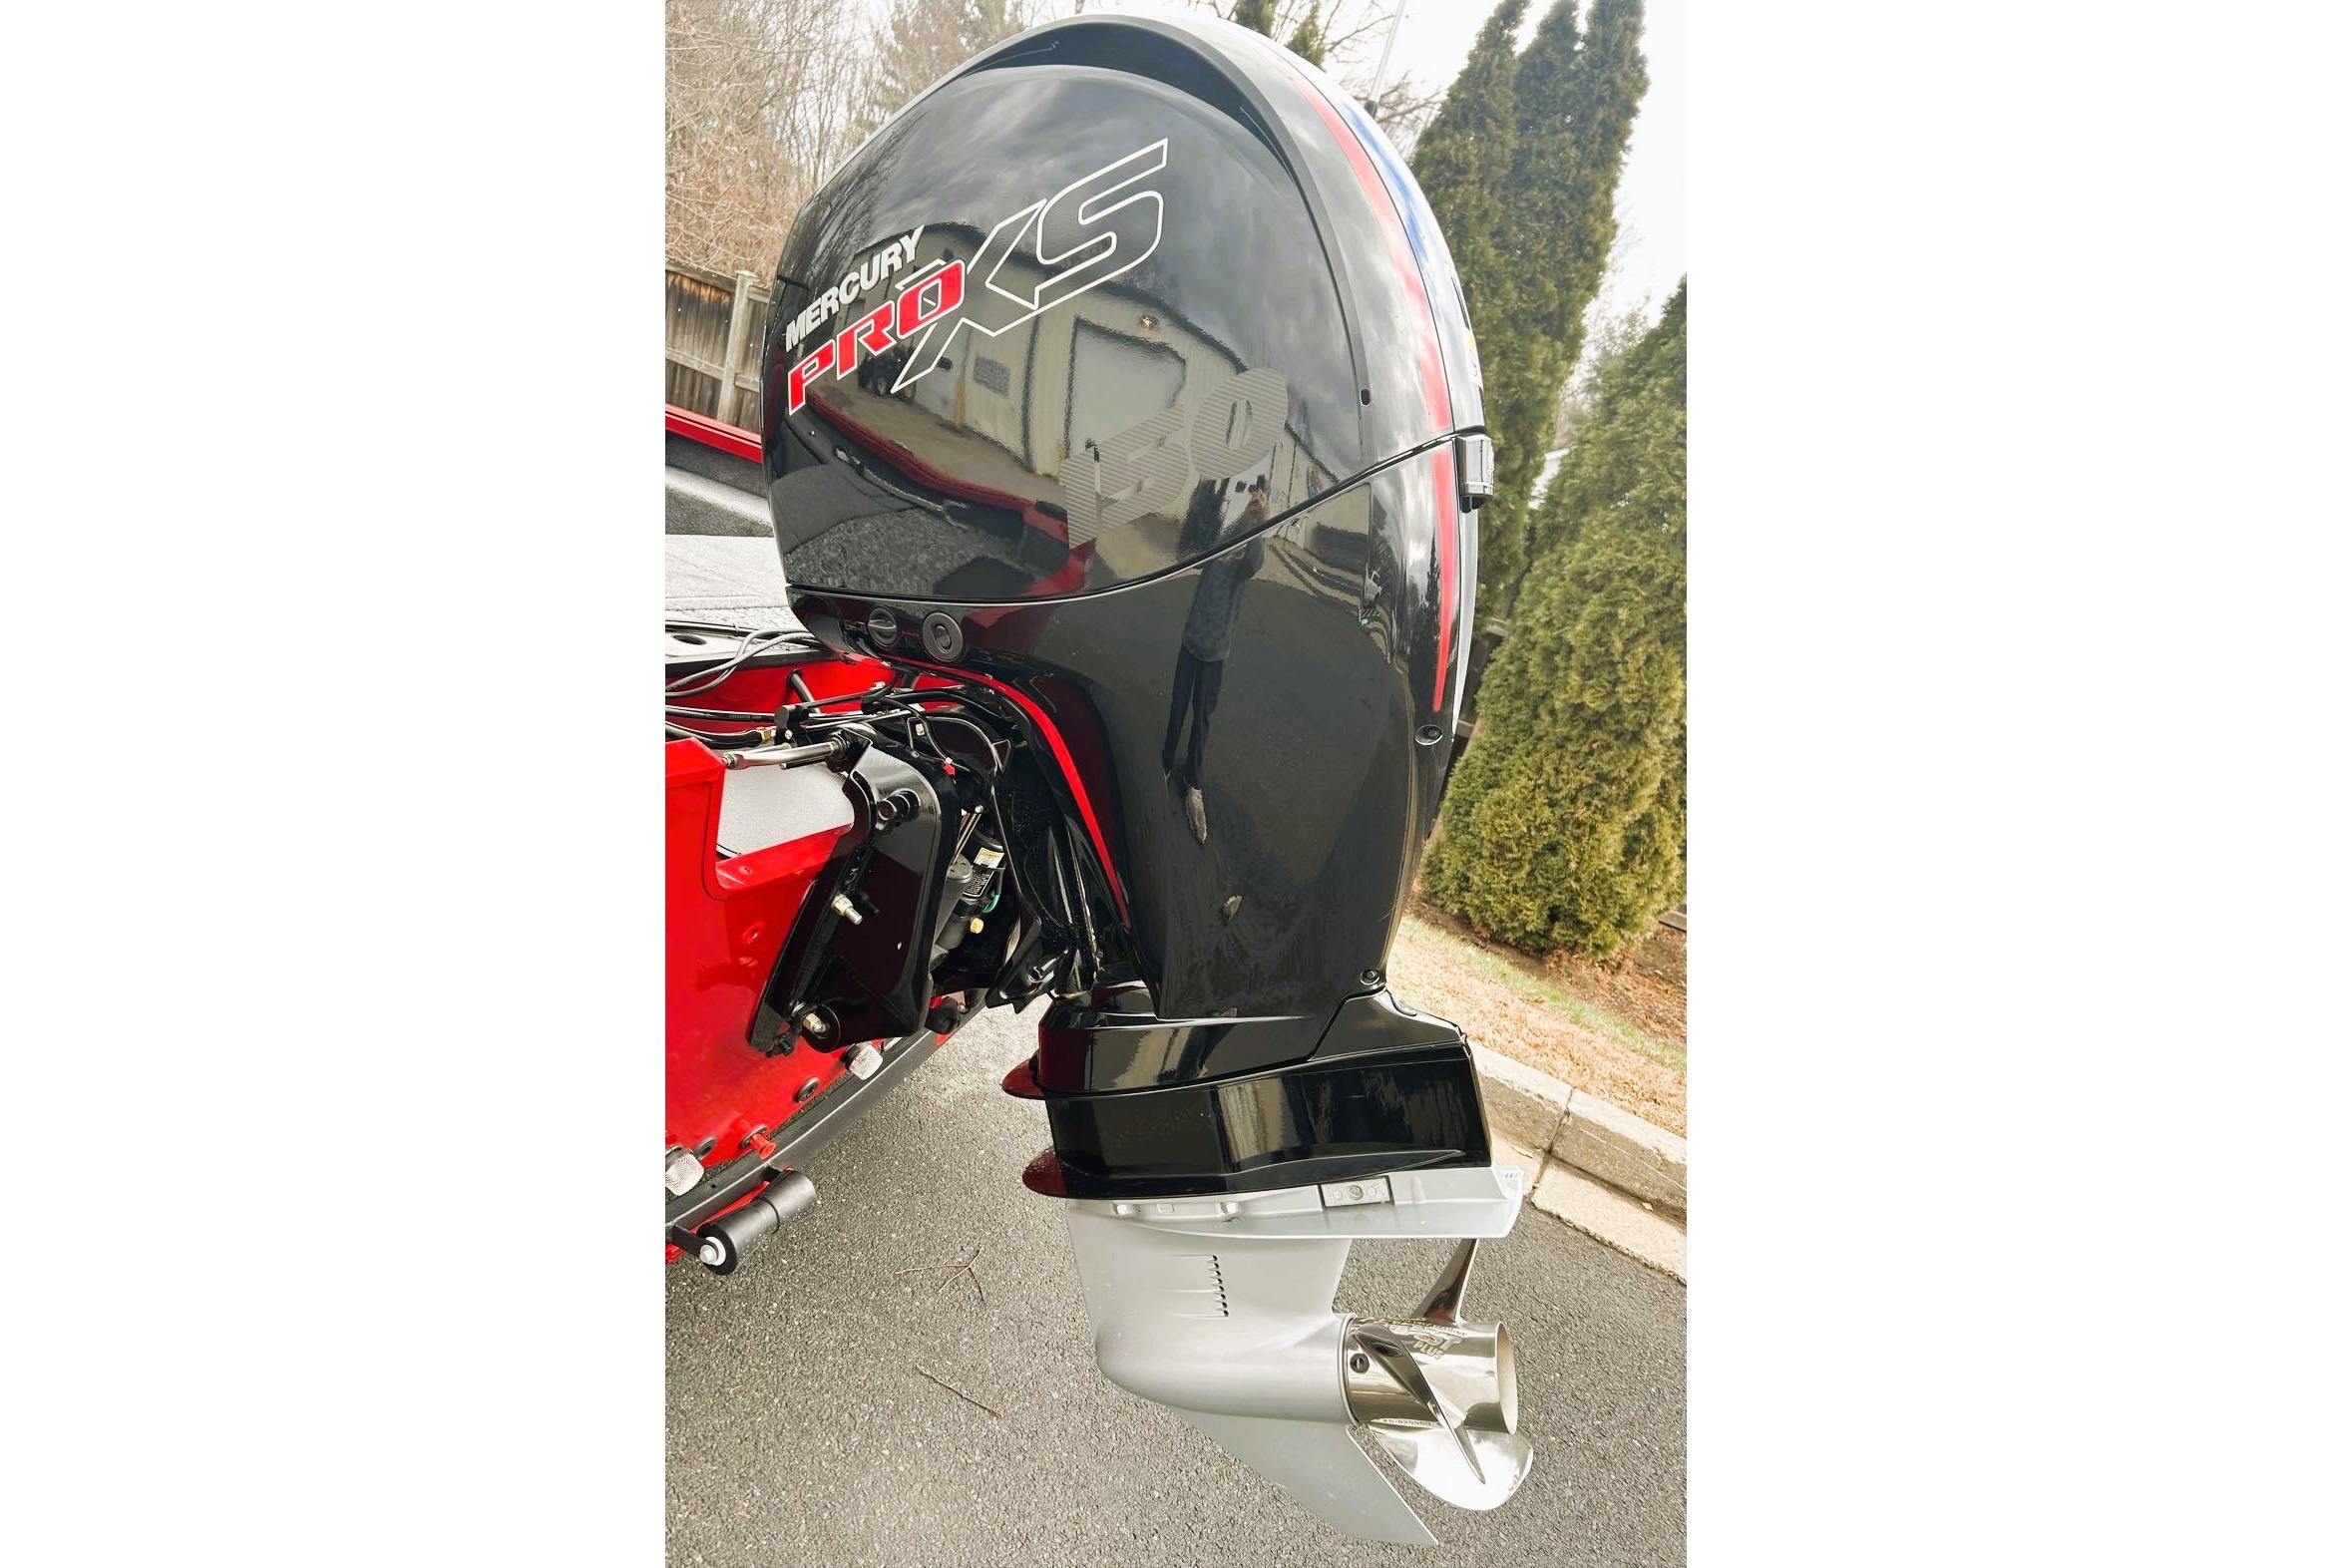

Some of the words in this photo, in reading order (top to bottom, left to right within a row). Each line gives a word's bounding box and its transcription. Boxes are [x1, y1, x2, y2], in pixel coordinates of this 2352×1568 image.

[785, 224, 925, 352] MERCURY
[787, 258, 967, 417] PRO
[890, 137, 1169, 395] XS
